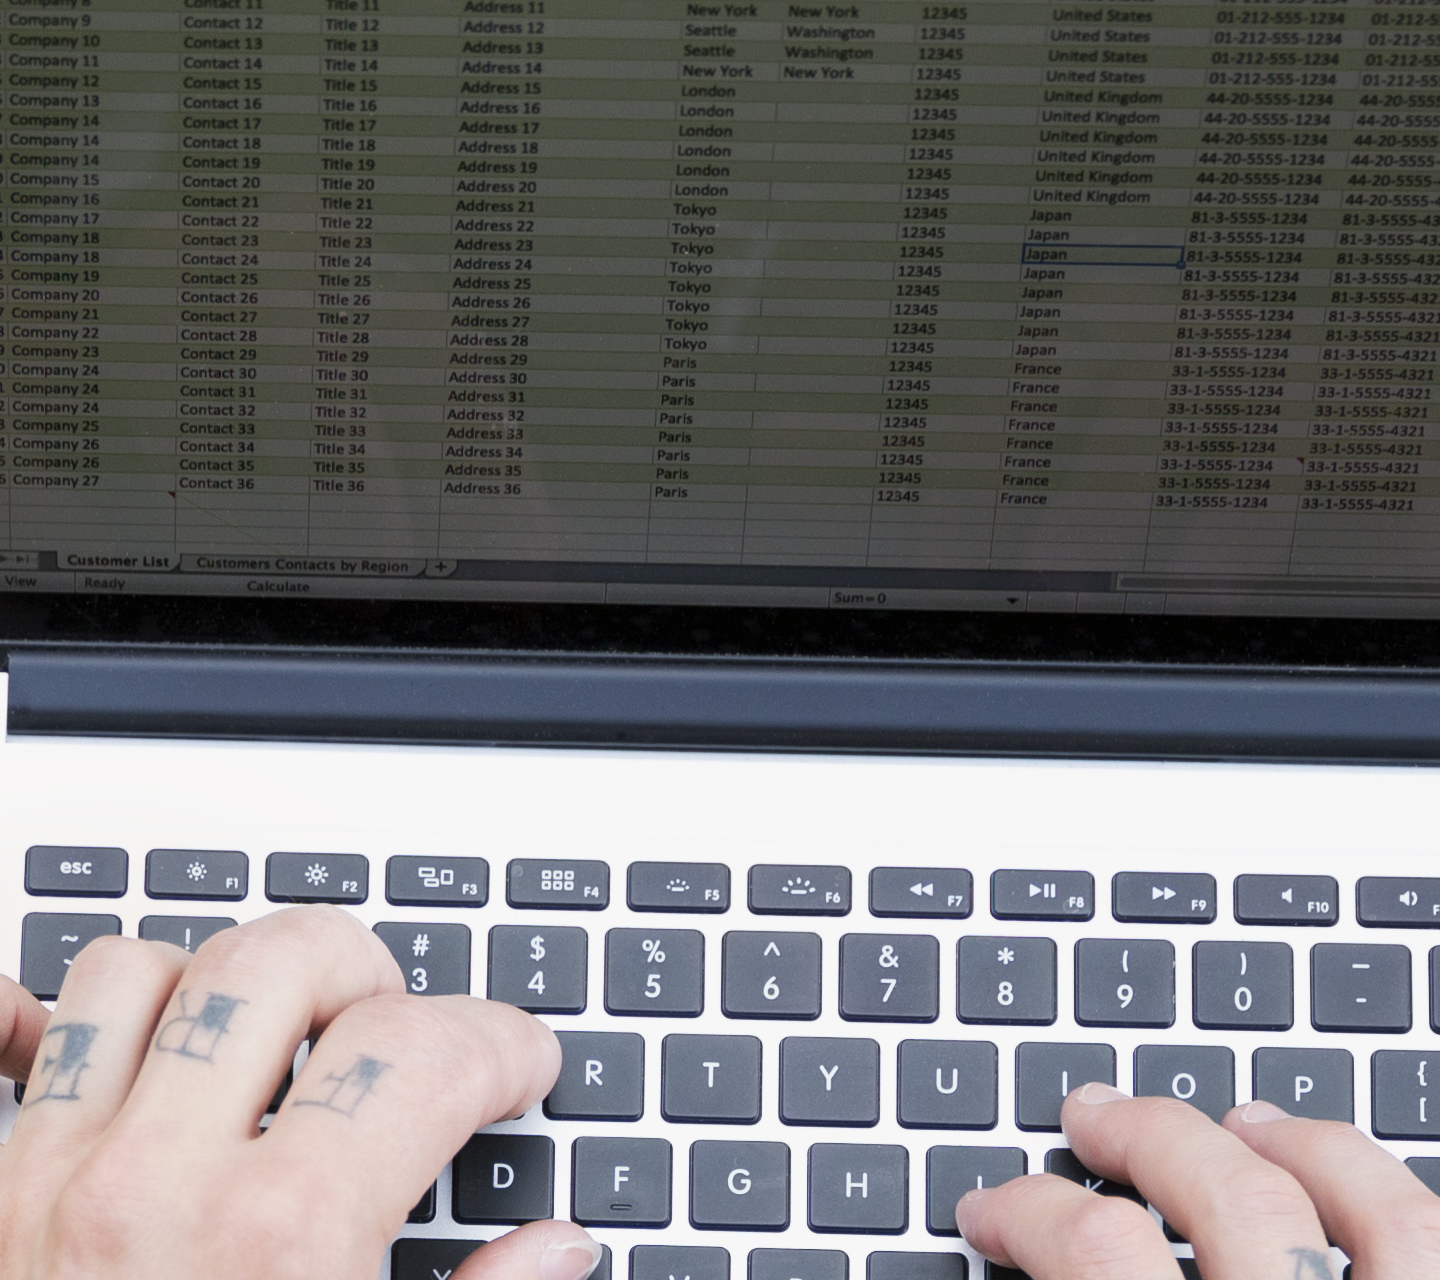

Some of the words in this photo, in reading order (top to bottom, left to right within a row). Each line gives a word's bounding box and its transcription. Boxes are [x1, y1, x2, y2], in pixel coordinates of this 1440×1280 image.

[8, 33, 78, 49] Company
[83, 35, 100, 47] 10
[183, 36, 240, 49] Contact
[246, 37, 263, 50] 13
[325, 39, 357, 51] Title
[362, 39, 378, 51] 13
[462, 41, 522, 54] Address
[527, 42, 543, 54] 13
[684, 45, 735, 57] Seattle
[785, 46, 873, 62] Washington
[919, 48, 963, 60] 12345
[1048, 50, 1098, 62] United
[1102, 50, 1148, 63] States
[1211, 52, 1339, 65] 01-212-555-1234
[9, 113, 78, 129] Company
[83, 115, 99, 127] 14
[183, 116, 238, 129] Contact
[244, 117, 261, 129] 17
[322, 119, 354, 131] Title
[359, 119, 377, 131] 17
[459, 121, 517, 134] Address
[523, 122, 539, 134] 17
[679, 125, 733, 137] London
[912, 128, 955, 141] 12345
[1040, 131, 1089, 143] United
[1093, 131, 1157, 146] Kingdom
[1201, 132, 1328, 146] 44-20-5555-1234
[10, 230, 79, 246] Company
[83, 232, 99, 244] 18
[181, 234, 237, 246] Contact
[241, 235, 258, 246] 23
[671, 242, 714, 257] Tokyo
[901, 246, 943, 258] 12345
[1026, 247, 1068, 263] Japan
[1186, 249, 1303, 265] 81-3-5555-1234
[13, 474, 79, 489] Company
[83, 475, 99, 486] 27
[179, 477, 232, 489] Contact
[238, 478, 254, 489] 36
[313, 480, 343, 491] Title
[348, 481, 364, 491] 36
[444, 482, 500, 494] Address
[504, 483, 521, 495] 36
[655, 486, 688, 498] Paris
[878, 490, 919, 502] 12345
[1001, 493, 1047, 504] France
[1156, 495, 1268, 508] 33-1-5555-1234
[1302, 498, 1413, 511] 33-1-5555-4321
[67, 554, 138, 566] Customer
[143, 556, 168, 567] List
[196, 556, 270, 569] Customers
[275, 558, 335, 570] Contacts
[339, 559, 358, 576] by
[361, 559, 409, 576] Region
[5, 575, 37, 587] View
[85, 577, 125, 591] Ready
[247, 580, 309, 593] Calculate
[59, 860, 93, 875] esc
[225, 877, 239, 890] F1
[342, 880, 358, 893] F2
[462, 883, 478, 896] F3
[583, 886, 600, 898] F4
[704, 888, 720, 902] F5
[825, 891, 841, 904] F6
[947, 894, 963, 907] F7
[1068, 896, 1085, 909] F8
[1191, 899, 1207, 911] F9
[1307, 901, 1330, 914] F10
[410, 967, 428, 992] 3
[527, 970, 546, 995] 4
[644, 973, 662, 999] 5
[762, 975, 780, 1000] 6
[879, 978, 897, 1003] 7
[997, 980, 1014, 1006] 8
[1116, 983, 1134, 1009] 9
[1234, 986, 1253, 1012] 0
[585, 1059, 603, 1086] R
[702, 1061, 721, 1088] T
[819, 1064, 839, 1092] Y
[935, 1067, 959, 1095] U
[1171, 1072, 1197, 1100] O
[1294, 1075, 1314, 1102] P
[492, 1162, 515, 1189] D
[613, 1165, 630, 1193] F
[727, 1168, 752, 1195] G
[845, 1171, 868, 1199] H
